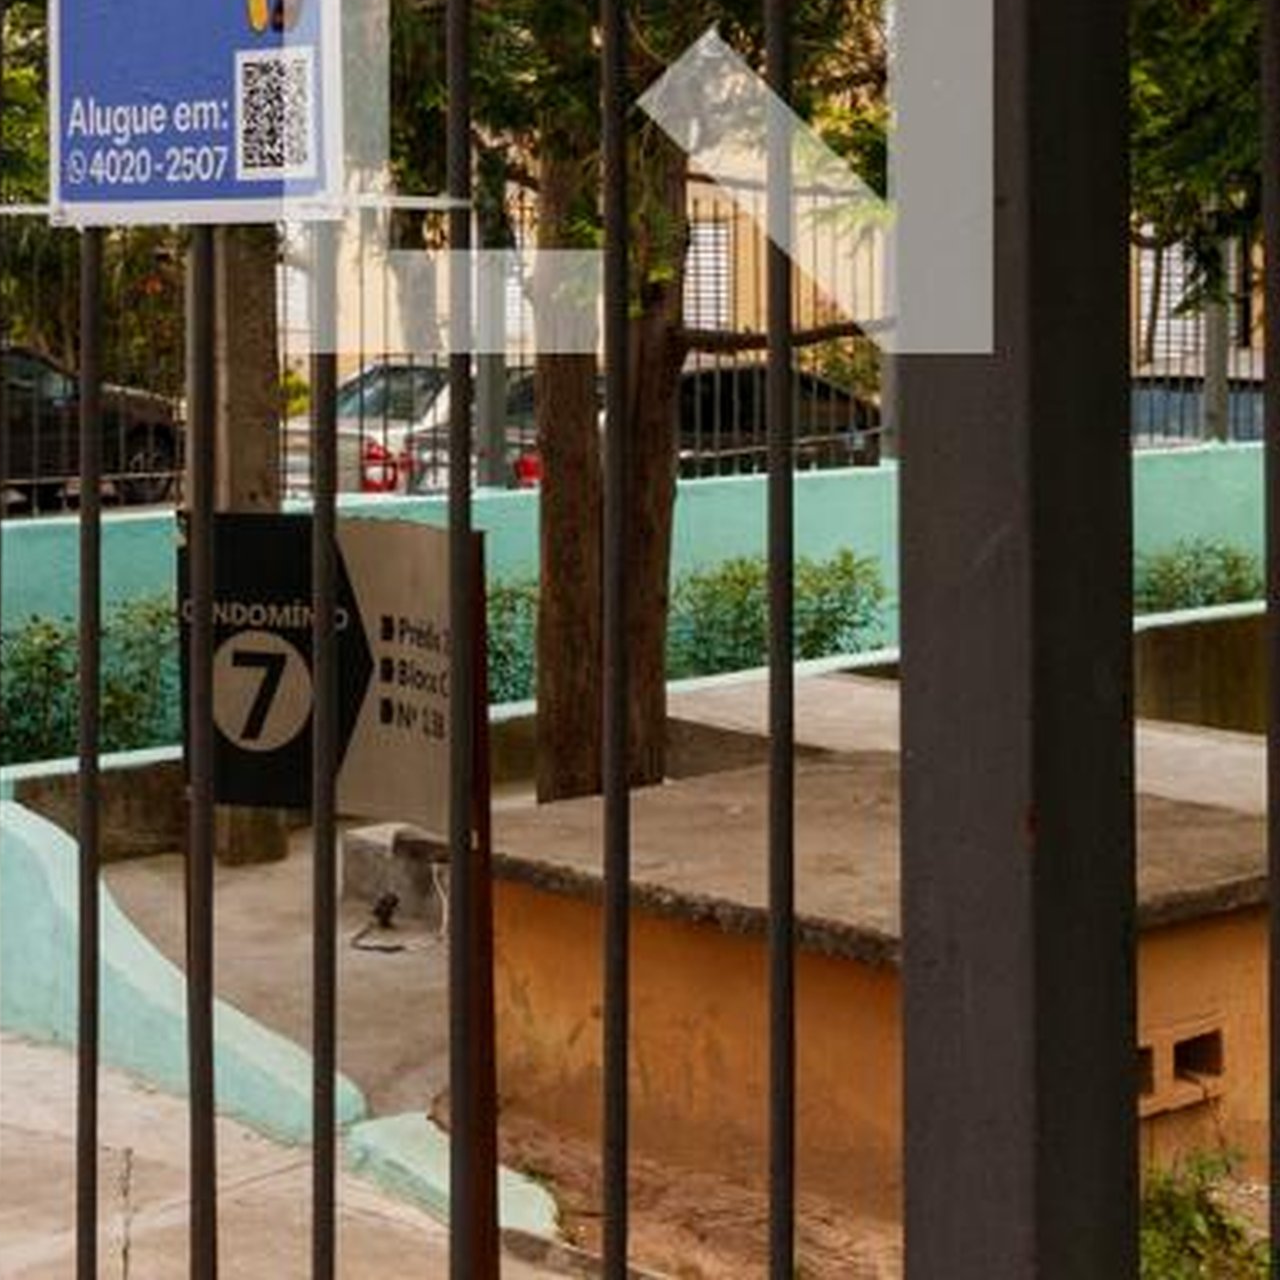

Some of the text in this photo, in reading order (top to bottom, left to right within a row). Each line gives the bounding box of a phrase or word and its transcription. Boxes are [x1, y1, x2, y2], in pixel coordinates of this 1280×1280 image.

[68, 97, 229, 146] Alugue em:
[232, 649, 287, 741] 7
